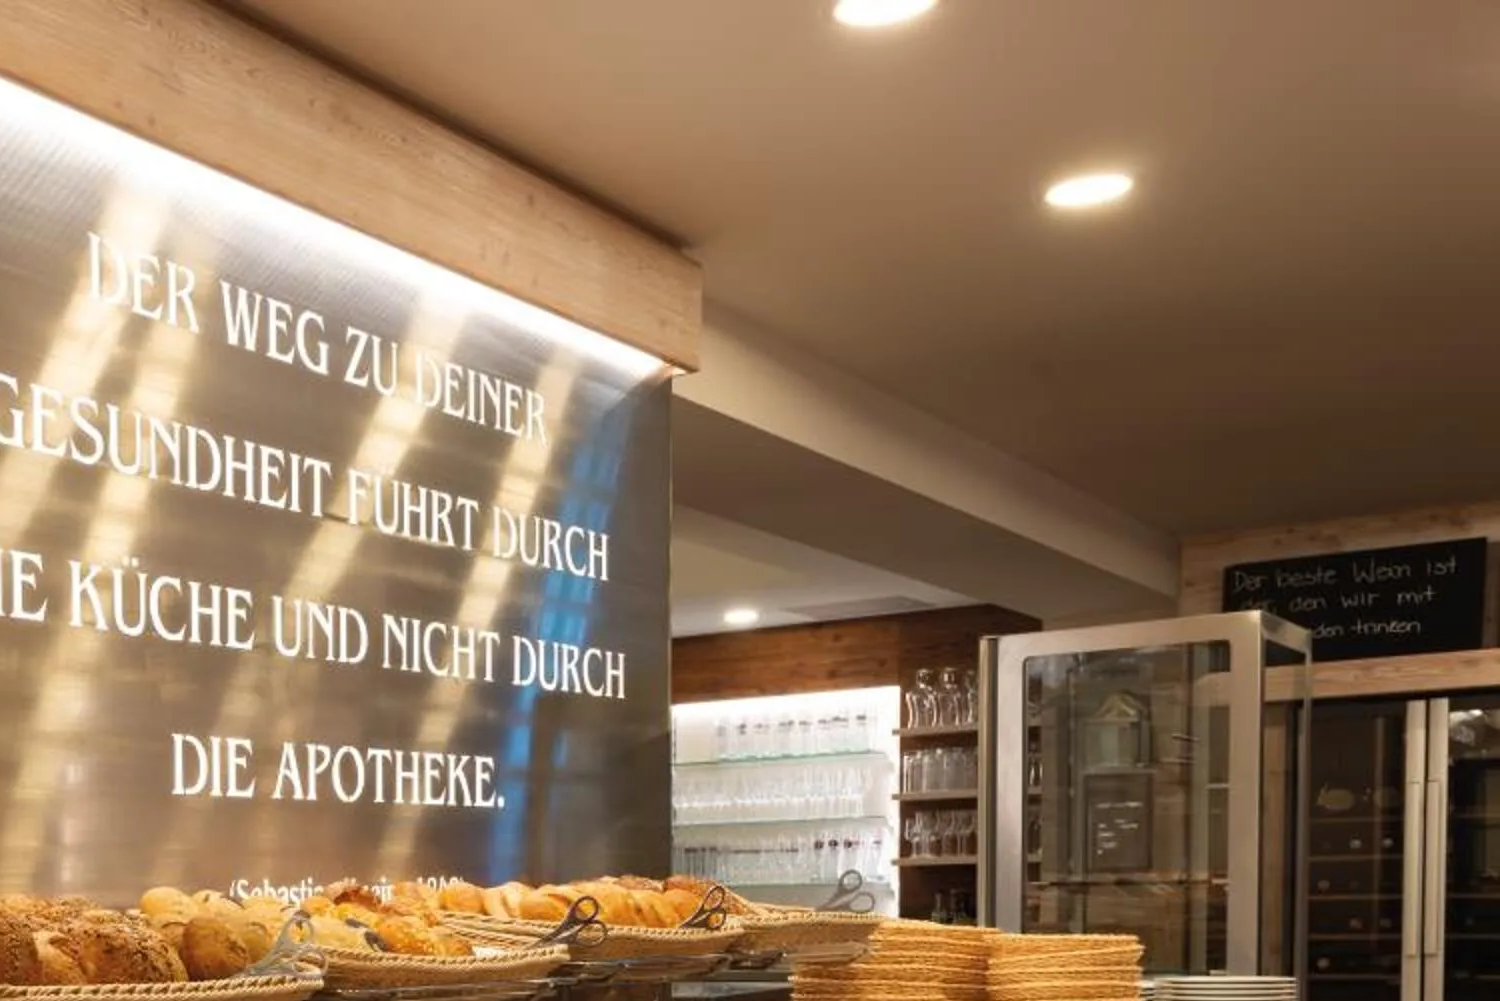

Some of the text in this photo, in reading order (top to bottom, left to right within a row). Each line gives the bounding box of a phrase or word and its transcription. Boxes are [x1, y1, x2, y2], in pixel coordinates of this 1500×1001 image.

[87, 231, 548, 448] DER WEG ZU DEINER
[491, 506, 610, 581] DURCH
[1234, 556, 1457, 593] Der beste Wein ist
[67, 555, 255, 650] KÜCHE
[271, 595, 369, 664] UND
[382, 614, 501, 683] NICHT
[511, 635, 626, 699] DURCH
[1289, 595, 1328, 613] den
[1341, 591, 1381, 609] wir
[1397, 584, 1437, 609] mit
[1352, 618, 1422, 637] trinken
[171, 733, 506, 809] DIE APOTHEKE.
